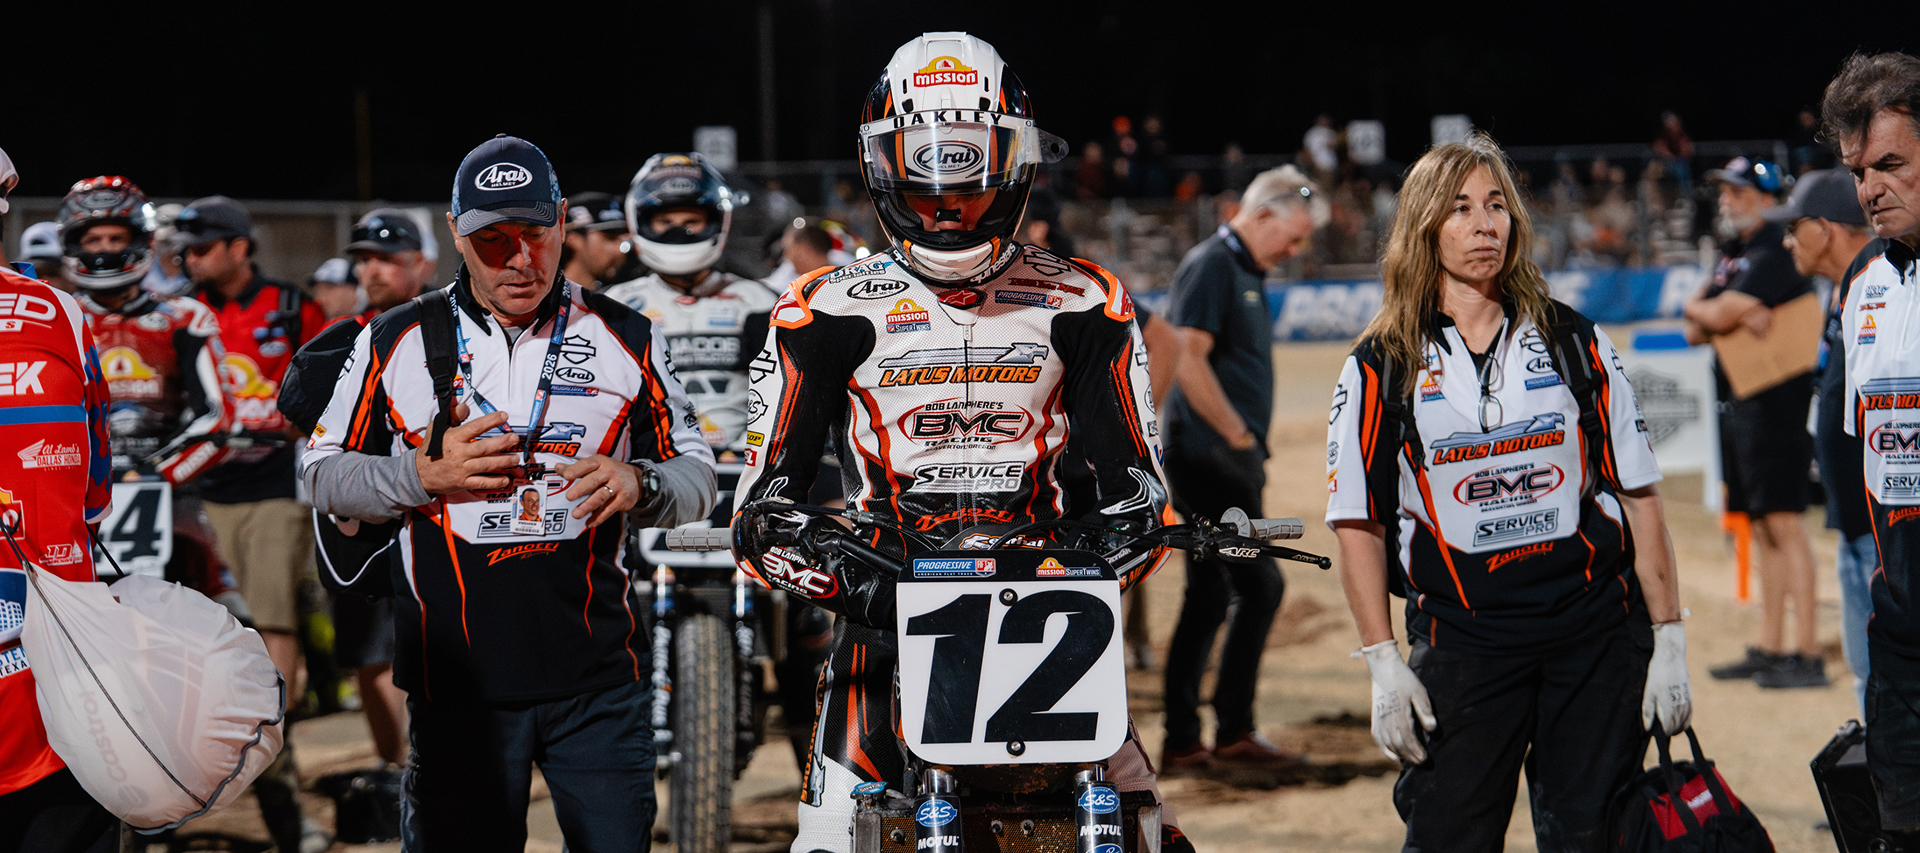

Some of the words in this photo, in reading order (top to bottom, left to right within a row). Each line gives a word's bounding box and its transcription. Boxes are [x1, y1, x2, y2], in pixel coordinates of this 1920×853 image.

[893, 111, 1001, 128] OAKLEY
[921, 147, 973, 165] Arai
[479, 166, 526, 185] Arai
[831, 261, 886, 279] DRAG
[853, 281, 902, 297] Arai
[997, 291, 1045, 302] PROGRESSIVE
[541, 353, 558, 380] 2026
[560, 367, 591, 380] Arai
[878, 366, 951, 387] LATUS
[949, 365, 1042, 384] MOTORS
[925, 403, 945, 412] BOB
[912, 412, 1023, 437] BMC
[1432, 443, 1491, 465] LATUS
[1490, 430, 1565, 457] MOTORS
[36, 455, 63, 467] DALLAS
[915, 465, 1022, 486] SERVICE
[1475, 469, 1490, 478] BOB
[974, 478, 1019, 490] PRO
[1467, 469, 1551, 501] BMC
[1477, 511, 1556, 538] SERVICE
[1525, 522, 1555, 536] PRO
[486, 543, 561, 567] Zanotti
[1219, 547, 1260, 558] ARC
[1485, 541, 1554, 573] Zanotti
[762, 554, 831, 594] BMC
[917, 561, 972, 570] PROGRESSIVE
[906, 589, 1115, 744] 12
[1083, 794, 1115, 806] S&S
[920, 806, 952, 820] S&S
[1080, 824, 1121, 837] MOTUL
[917, 835, 959, 850] MOTUL
